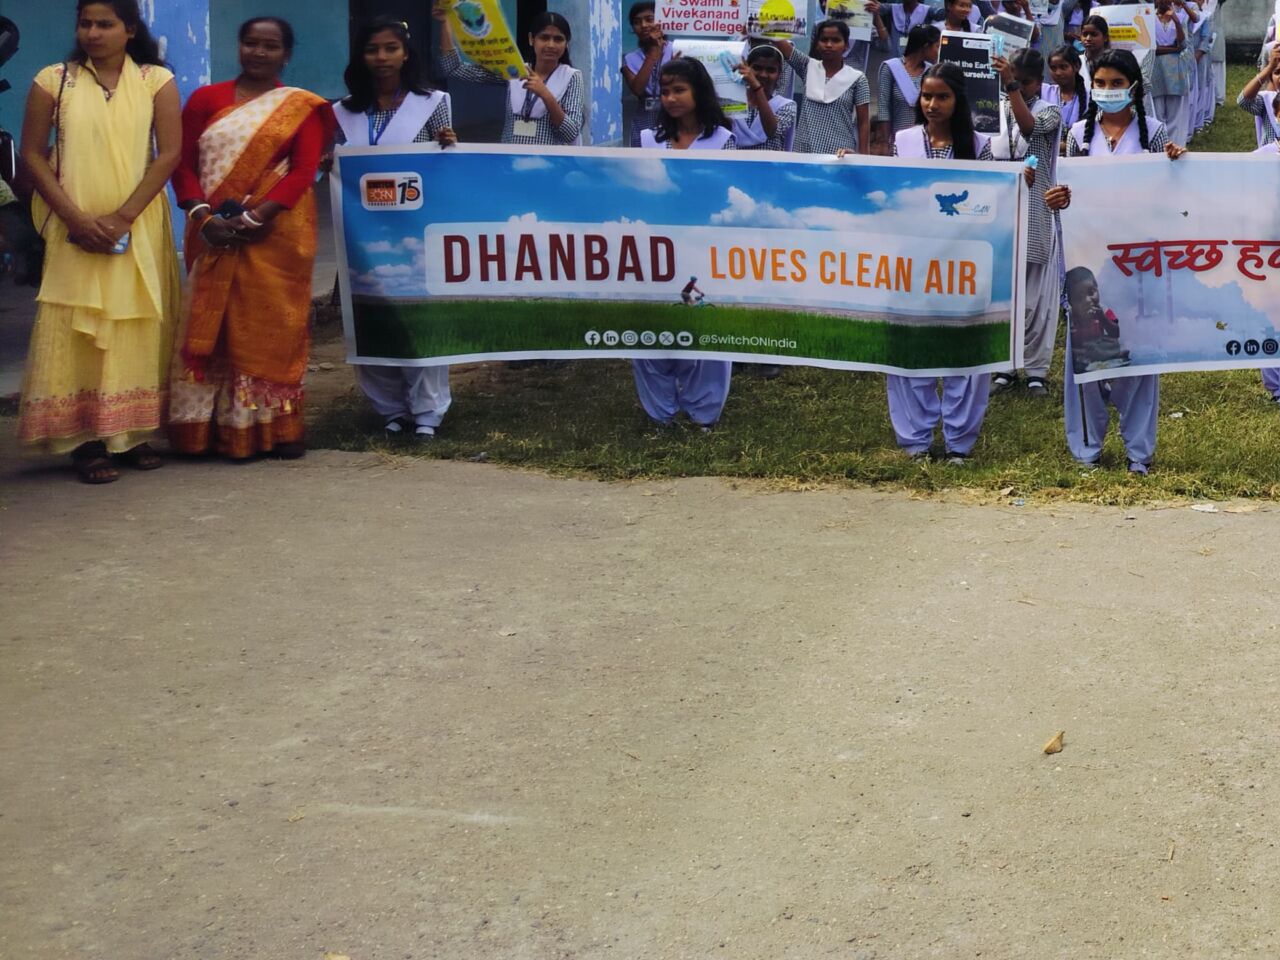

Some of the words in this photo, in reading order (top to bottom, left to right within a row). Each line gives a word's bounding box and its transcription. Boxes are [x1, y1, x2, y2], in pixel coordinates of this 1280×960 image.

[662, 7, 740, 20] Vivekanand
[693, 20, 743, 34] College
[398, 179, 420, 205] 15
[442, 233, 676, 283] DHANBAD
[710, 246, 806, 282] LOVES
[819, 250, 912, 293] CLEAN
[924, 259, 977, 296] AIR
[1107, 240, 1228, 278] स्वच्छ
[698, 334, 797, 350] @SwitchONIndia
